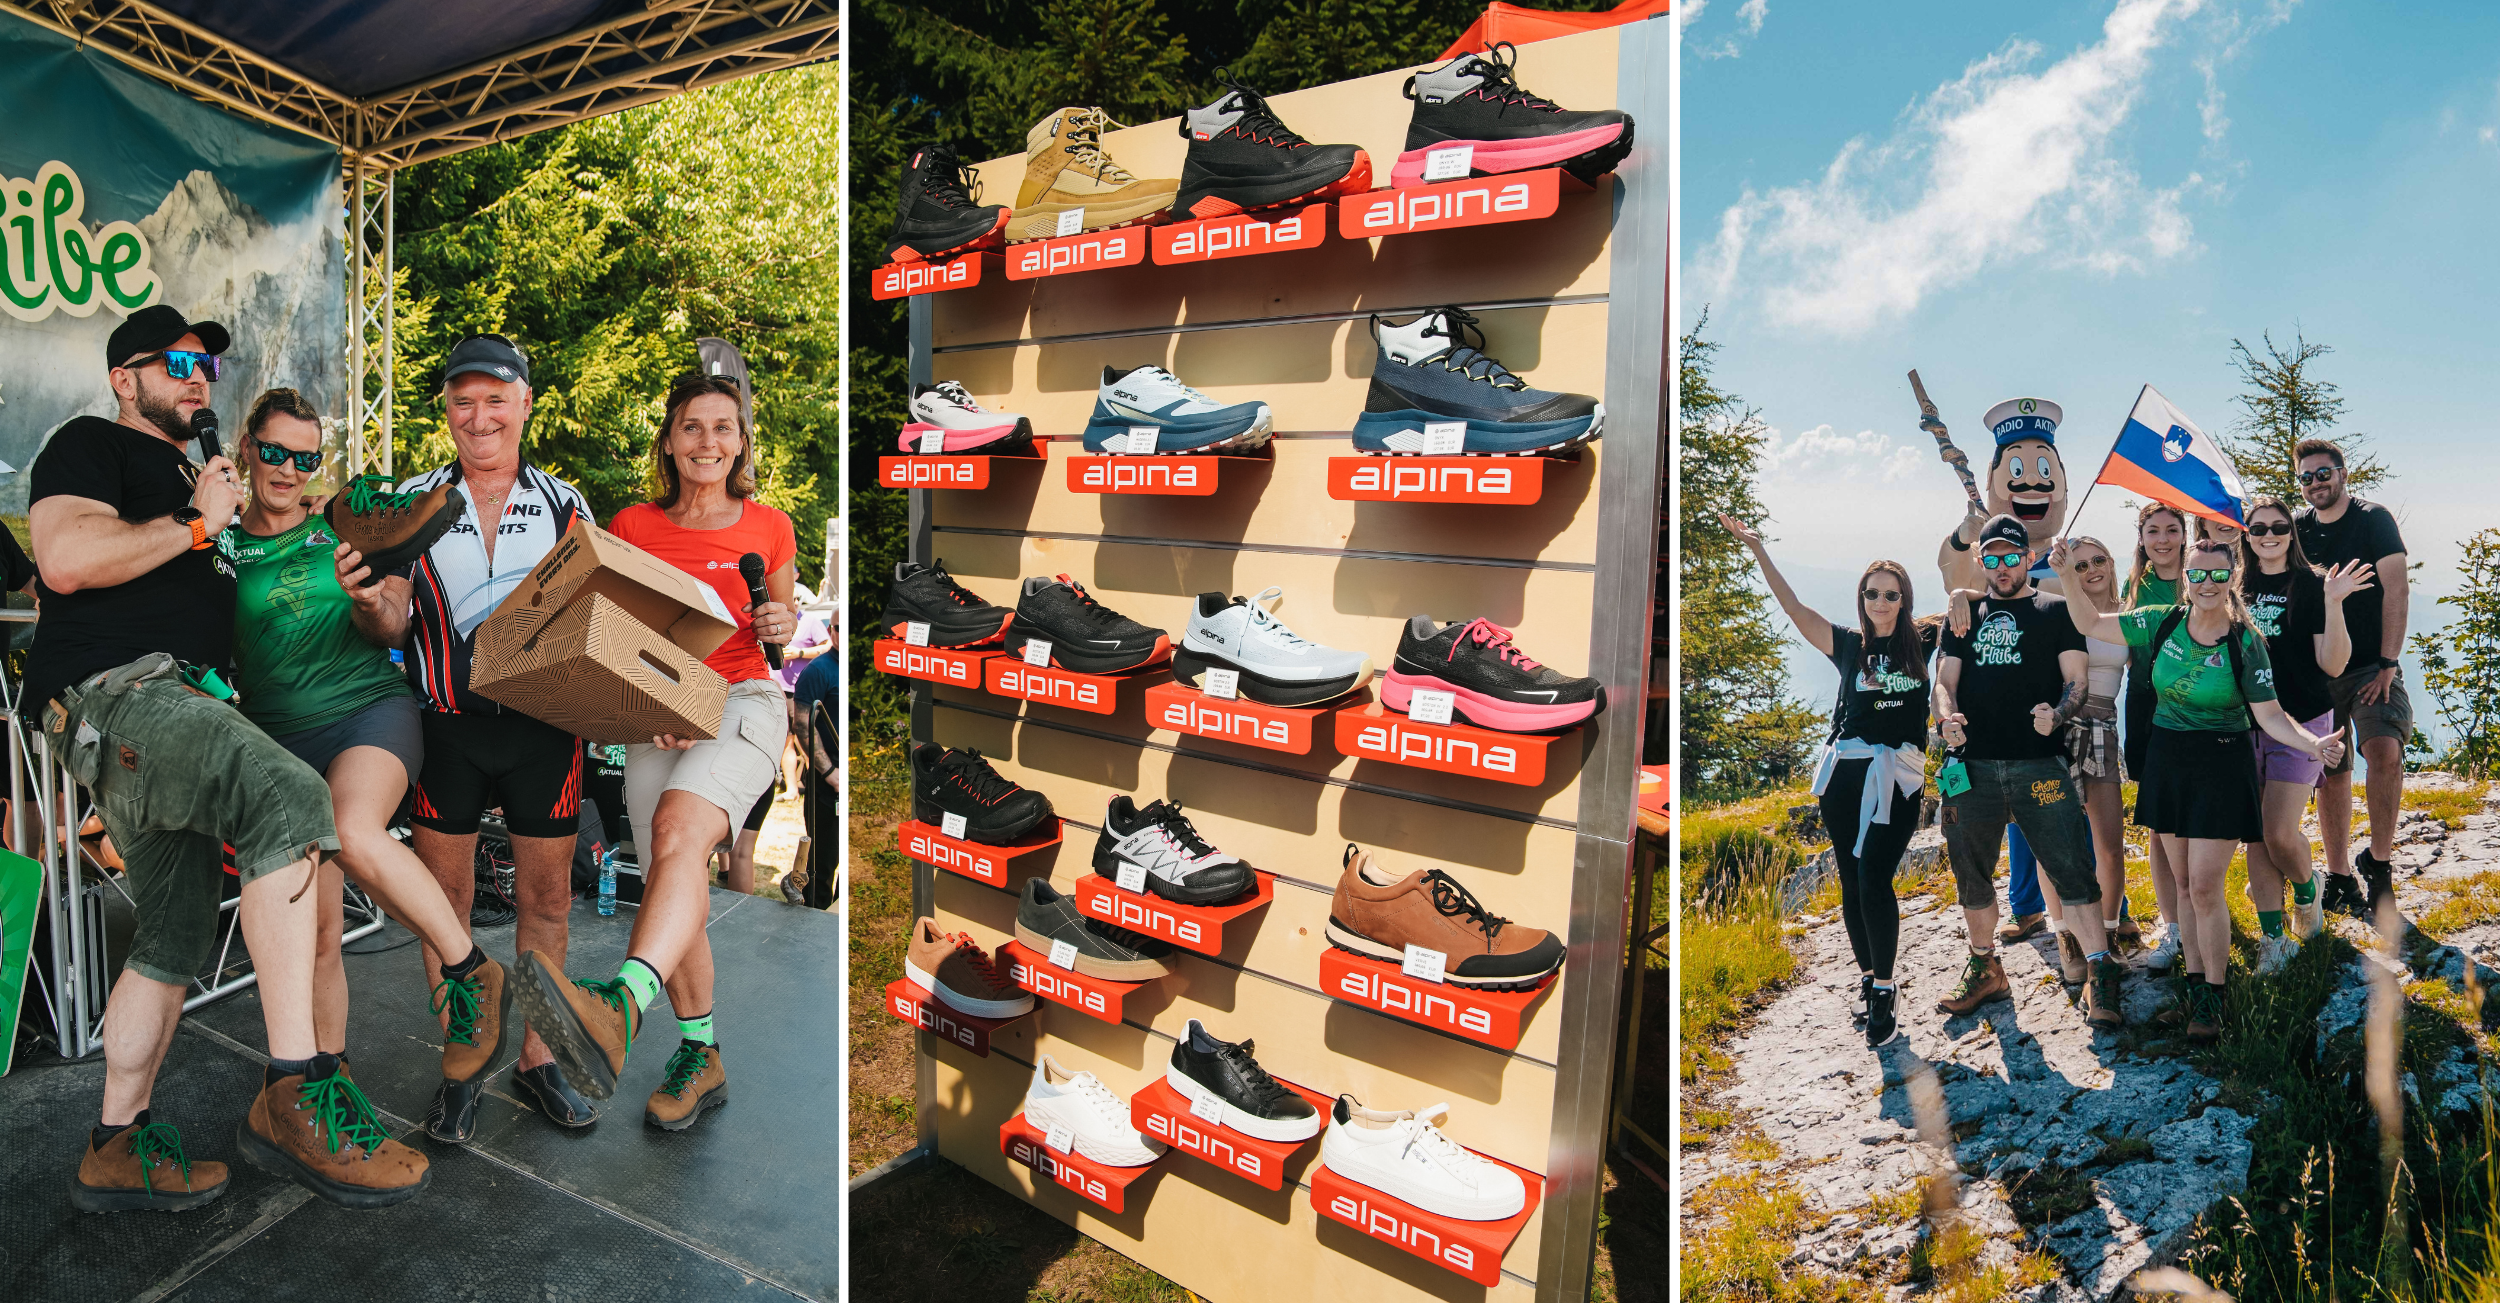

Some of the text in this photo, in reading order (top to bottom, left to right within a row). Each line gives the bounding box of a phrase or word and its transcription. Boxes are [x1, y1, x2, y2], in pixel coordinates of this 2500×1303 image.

[1363, 184, 1529, 231] alpina
[1021, 237, 1126, 276] alpina
[1171, 216, 1302, 259] alpina
[883, 262, 967, 294] alpina
[1113, 389, 1138, 402] alpina
[1996, 418, 2056, 438] RADIO AKTU
[891, 460, 974, 487] alpina
[1083, 461, 1197, 491] alpina
[1350, 460, 1512, 498] alpina
[450, 523, 528, 536] SPRTS
[536, 536, 578, 581] CHALLENGE.
[539, 562, 563, 589] EVERY
[720, 562, 740, 570] alp
[2256, 593, 2288, 605] LAŠKO
[1200, 628, 1225, 645] alpina
[885, 648, 967, 680] alpina
[1000, 669, 1099, 705] alpina
[1164, 701, 1289, 745] alpina
[1357, 724, 1517, 773] alpina
[910, 836, 993, 878] alpina
[1091, 893, 1201, 944] alpina
[1009, 963, 1105, 1013] alpina
[1340, 973, 1491, 1035] alpina
[895, 994, 975, 1047] alpina
[1146, 1112, 1261, 1177] alpina
[1013, 1142, 1107, 1202] alpina
[1330, 1195, 1474, 1271] alpina
